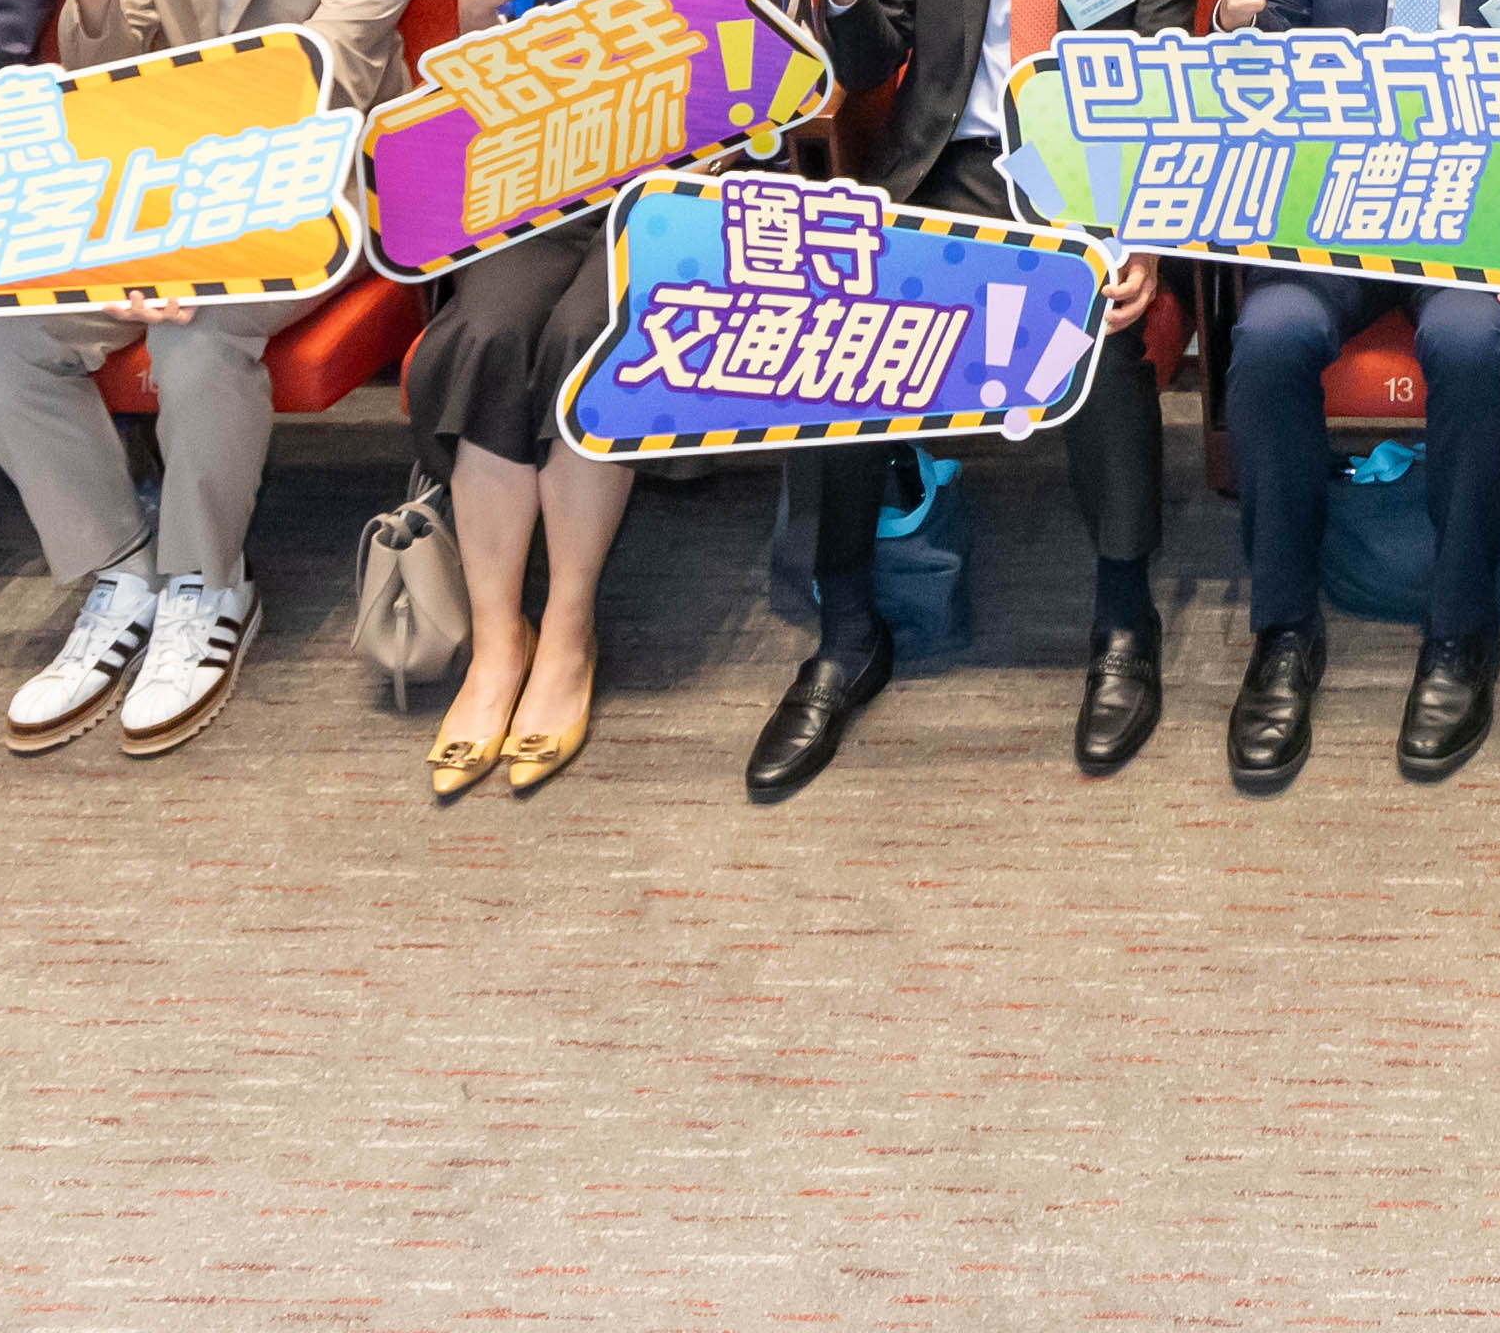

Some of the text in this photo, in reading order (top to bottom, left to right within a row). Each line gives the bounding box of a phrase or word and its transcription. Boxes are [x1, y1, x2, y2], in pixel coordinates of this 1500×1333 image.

[469, 68, 685, 230] 靠晒你
[1124, 141, 1293, 240] 留心
[1314, 141, 1484, 240] 禮讓
[726, 182, 881, 296] 遵守
[618, 285, 969, 408] 交通規則
[1383, 376, 1414, 403] 13
